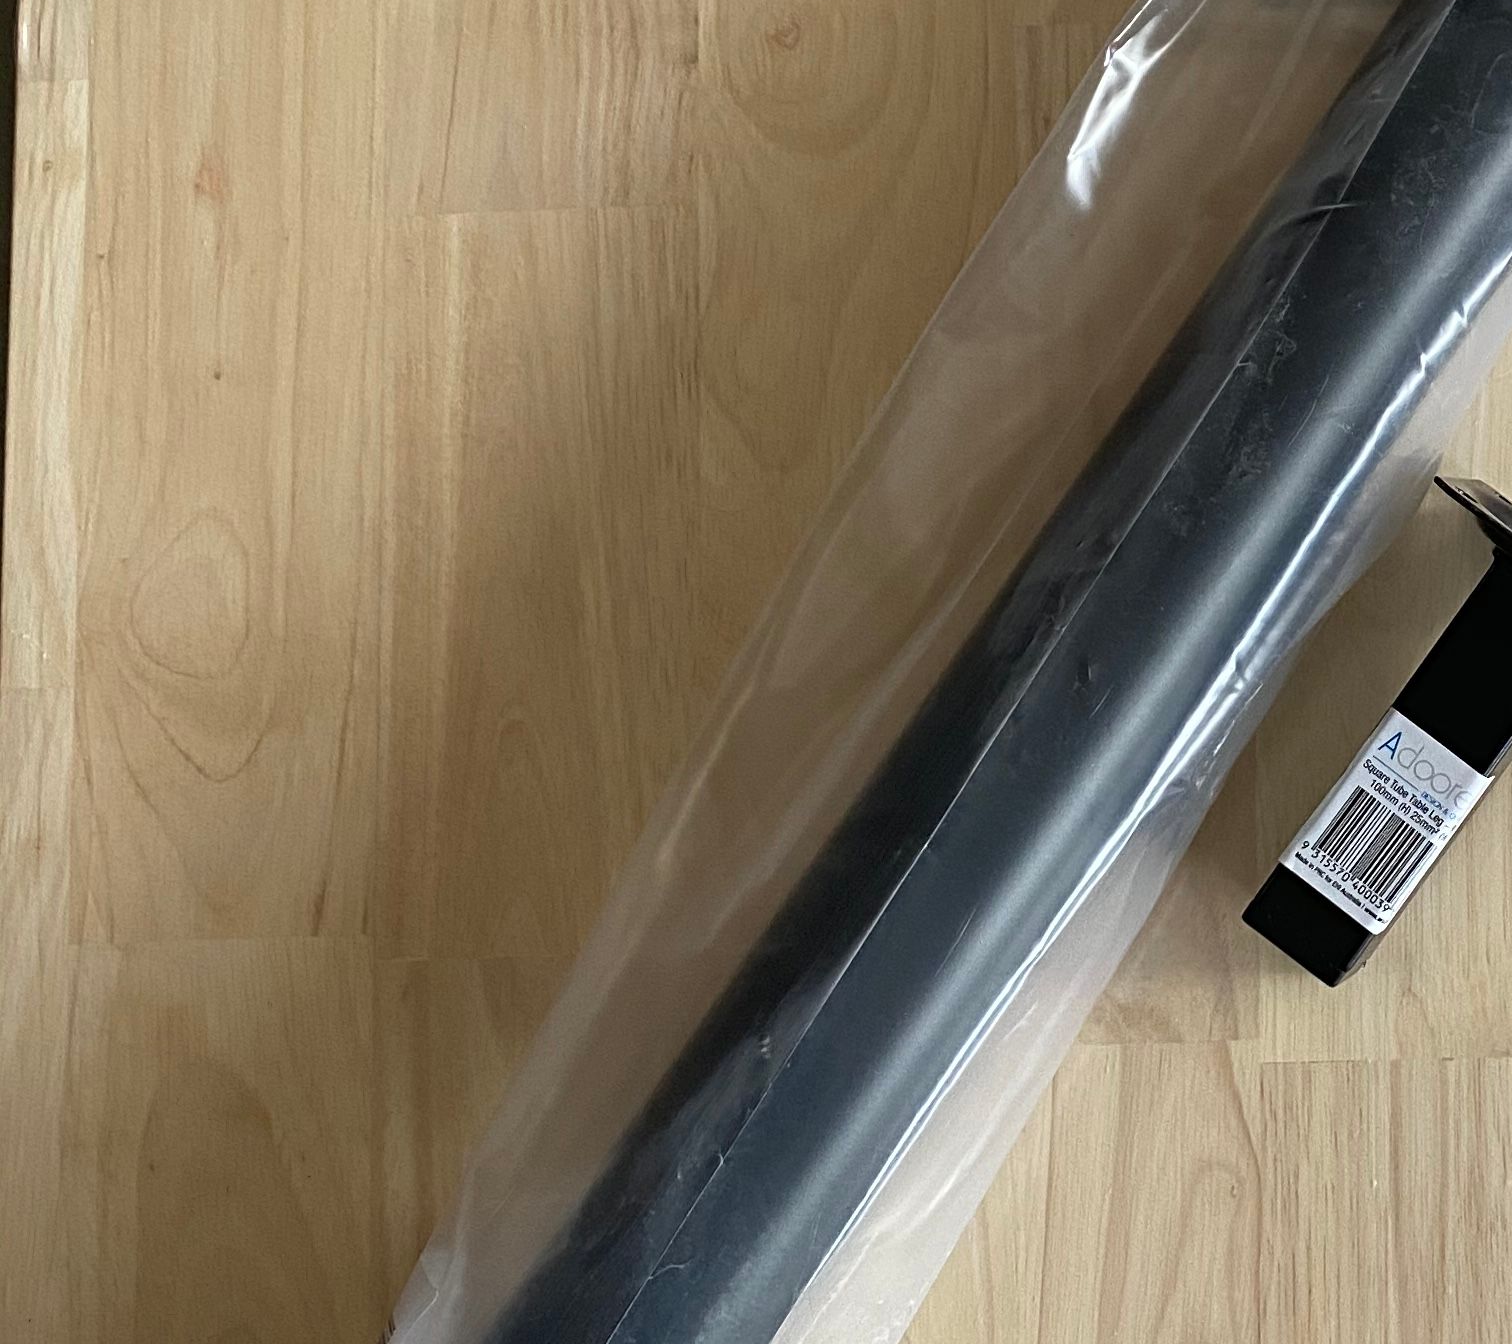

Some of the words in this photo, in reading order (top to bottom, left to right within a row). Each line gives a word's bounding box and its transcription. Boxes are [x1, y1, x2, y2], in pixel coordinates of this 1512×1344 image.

[1363, 758, 1391, 785] Square
[1390, 778, 1410, 799] Tube
[1408, 793, 1430, 815] Table
[1429, 809, 1445, 828] Leg
[1370, 779, 1399, 806] 100mm
[1397, 802, 1412, 816] (H)
